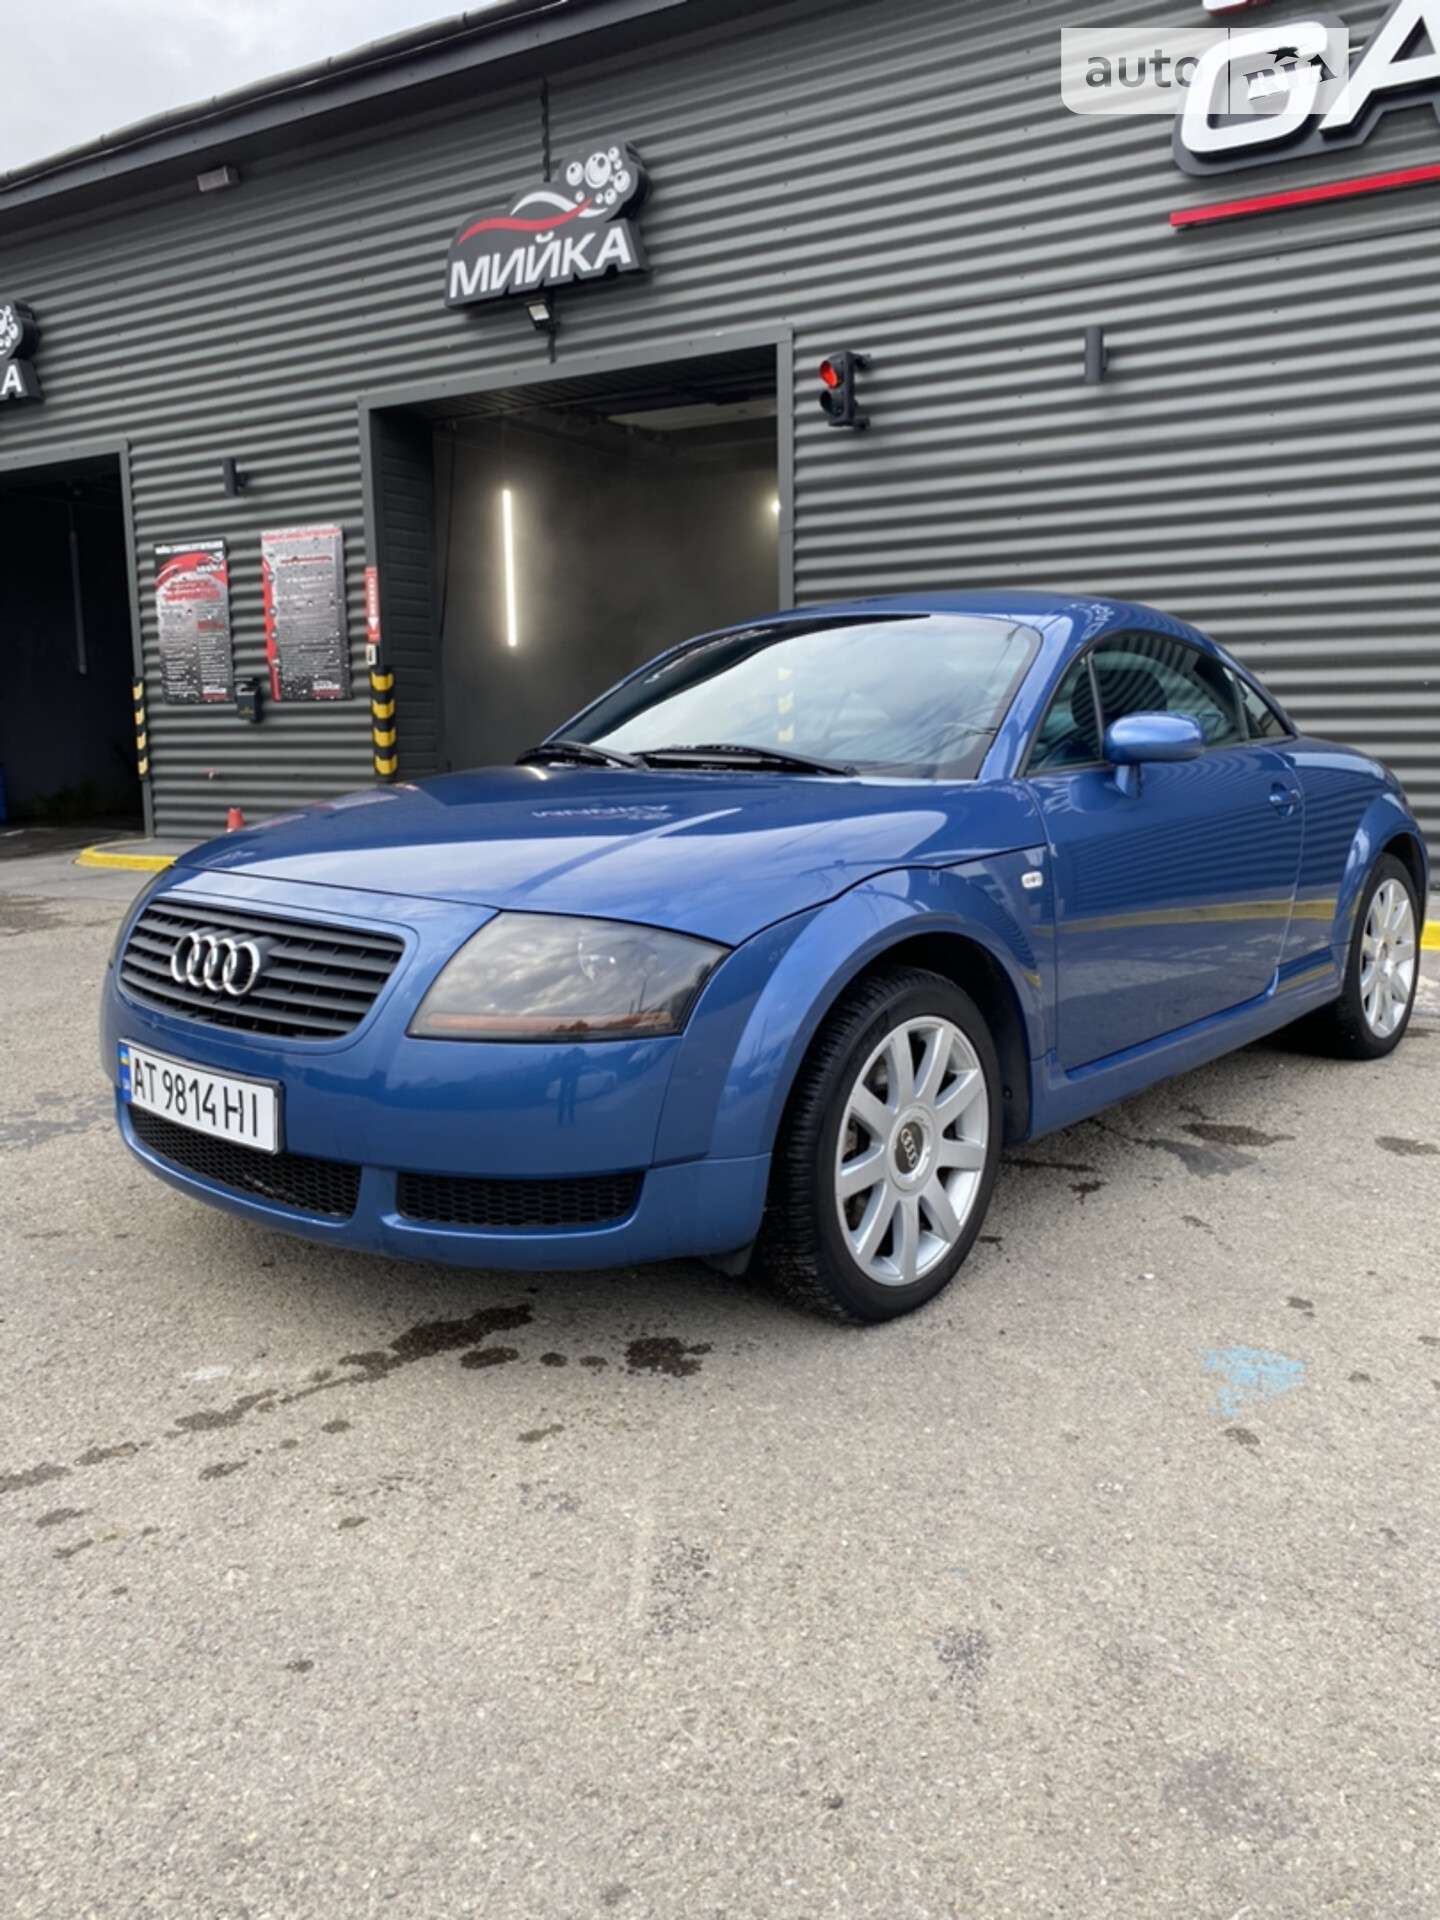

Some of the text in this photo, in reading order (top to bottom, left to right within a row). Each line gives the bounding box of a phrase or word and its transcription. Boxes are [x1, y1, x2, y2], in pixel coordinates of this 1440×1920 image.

[449, 226, 632, 299] МИЙКА
[0, 364, 23, 396] А
[134, 1057, 258, 1138] AT 9814 HI
